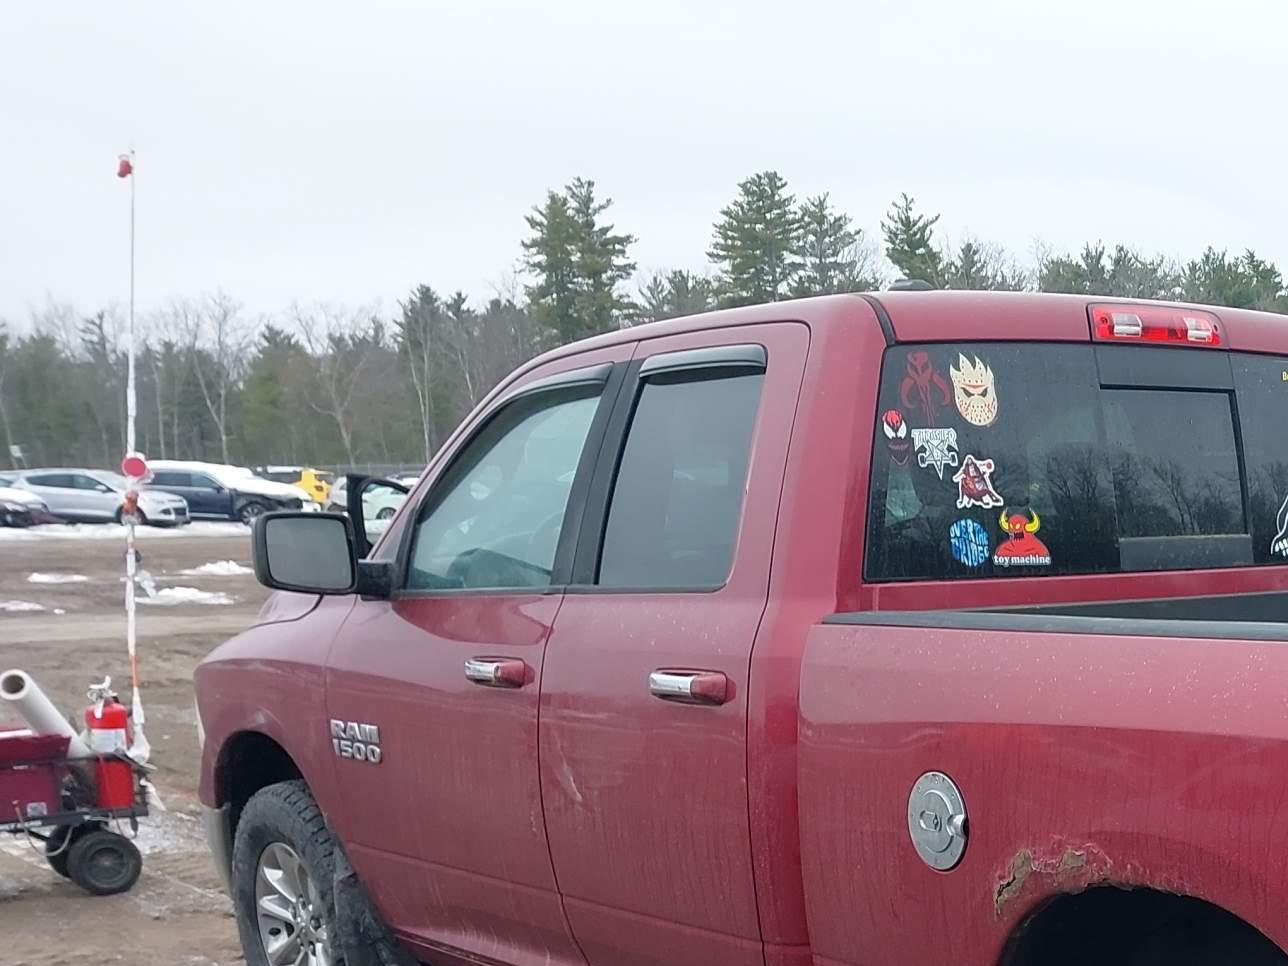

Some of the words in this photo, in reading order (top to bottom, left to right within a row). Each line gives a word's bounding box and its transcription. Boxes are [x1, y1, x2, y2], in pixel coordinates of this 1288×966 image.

[949, 518, 975, 543] OVER
[994, 554, 1009, 567] toy
[1011, 553, 1051, 565] machine
[330, 719, 379, 744] RAM
[332, 738, 381, 763] 1500
